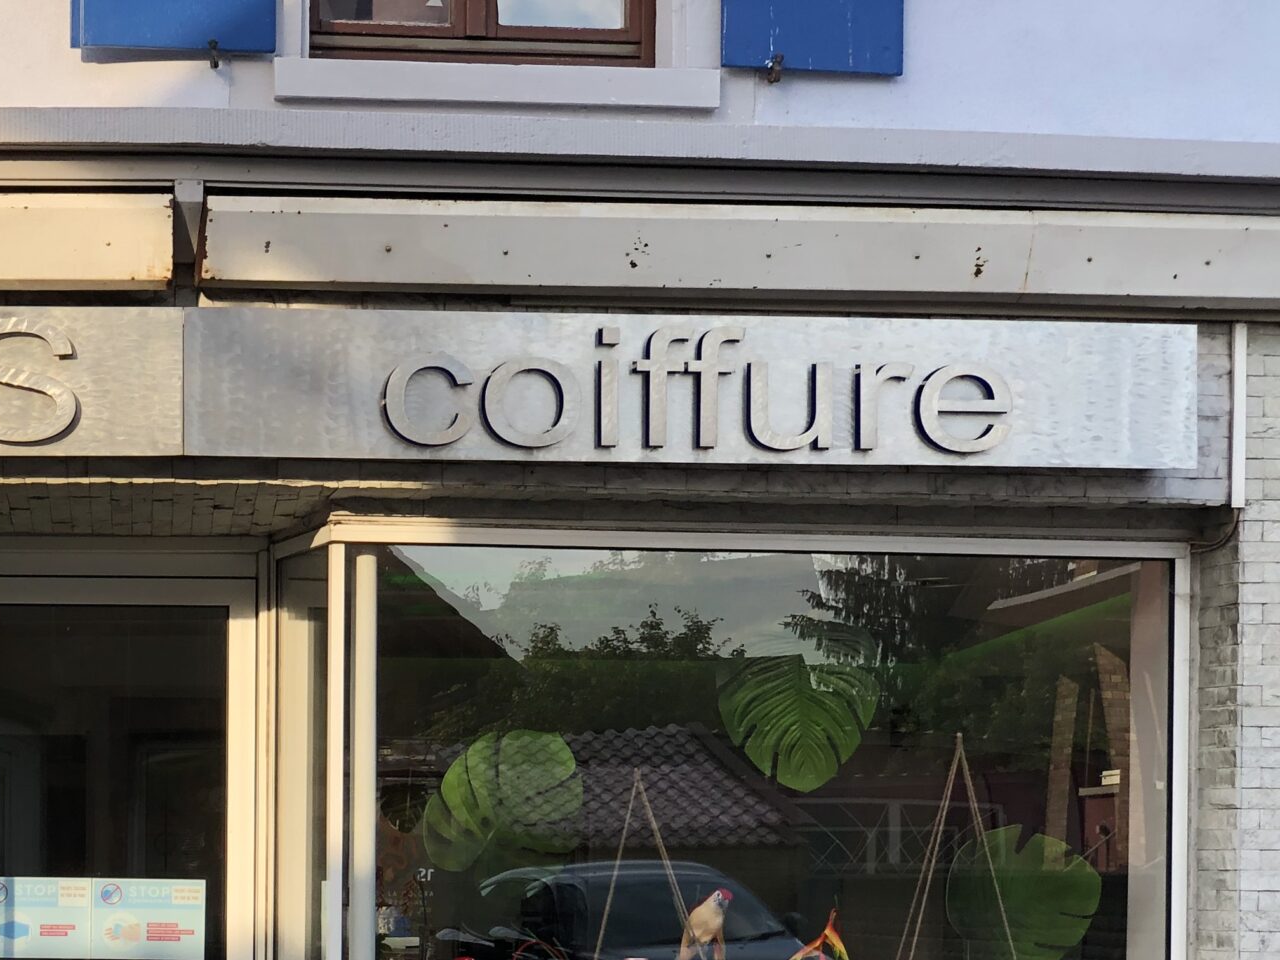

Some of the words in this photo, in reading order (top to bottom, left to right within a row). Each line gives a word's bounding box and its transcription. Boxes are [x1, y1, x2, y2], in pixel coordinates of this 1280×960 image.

[381, 325, 1013, 454] coiffure
[15, 884, 57, 896] STOP
[129, 886, 169, 898] STOP
